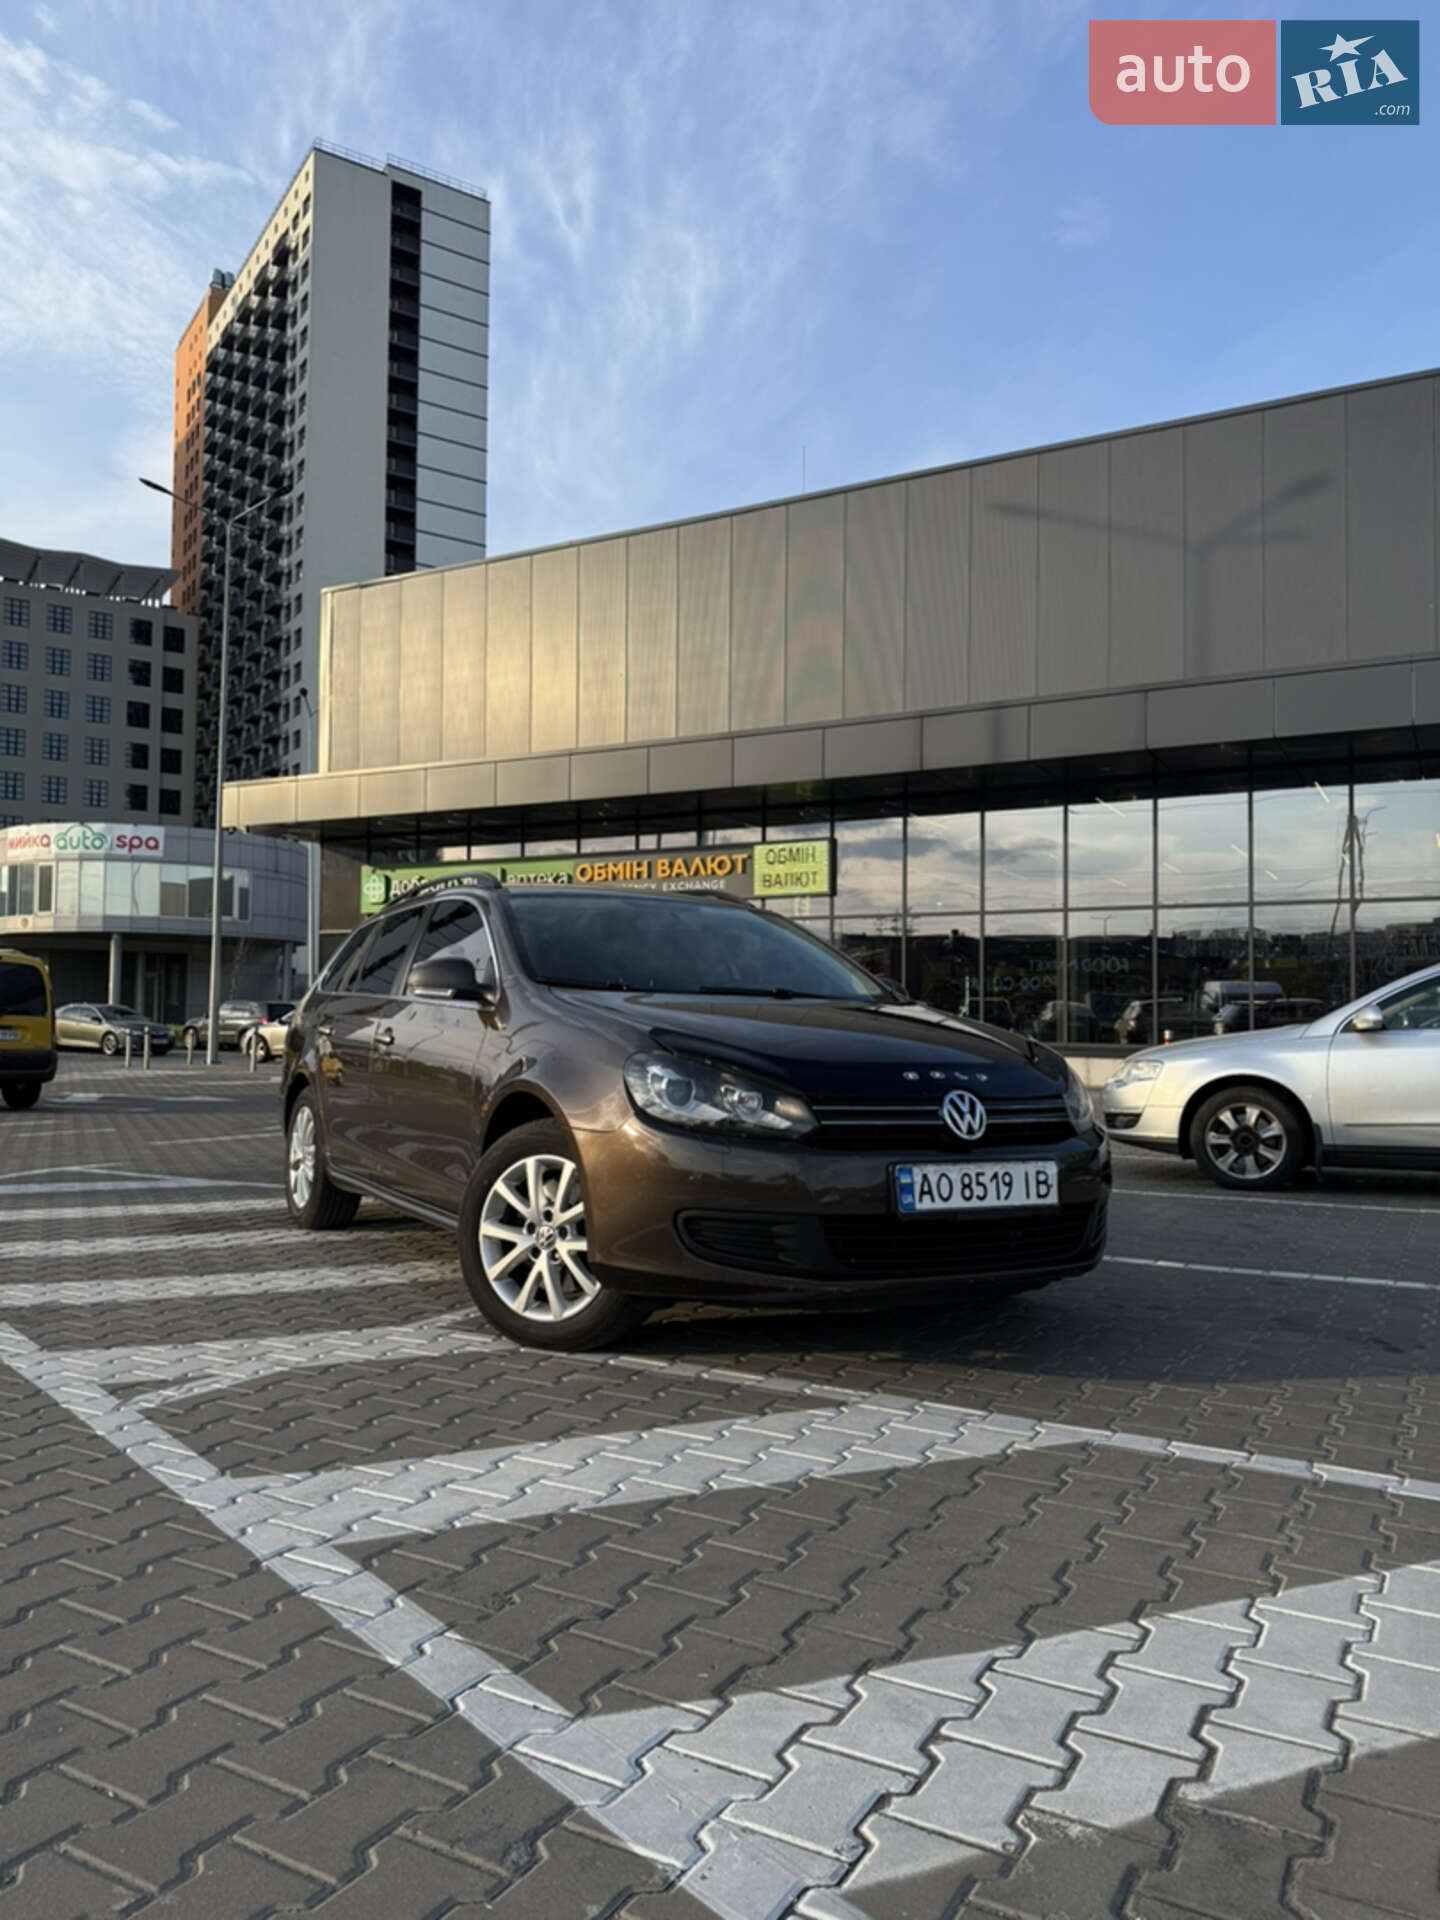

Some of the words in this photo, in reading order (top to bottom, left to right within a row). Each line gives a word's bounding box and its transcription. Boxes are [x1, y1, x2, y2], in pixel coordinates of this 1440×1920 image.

[57, 830, 104, 850] auto
[116, 835, 159, 853] spa
[765, 846, 816, 865] ОБМІН
[575, 860, 648, 882] ОБМІН
[656, 853, 747, 878] ВАЛЮТ
[662, 879, 726, 891] EXCHANGE
[762, 871, 818, 888] ВАЛЮТ
[918, 1173, 953, 1203] AO
[961, 1171, 1013, 1201] 8519
[1025, 1170, 1051, 1199] IB
